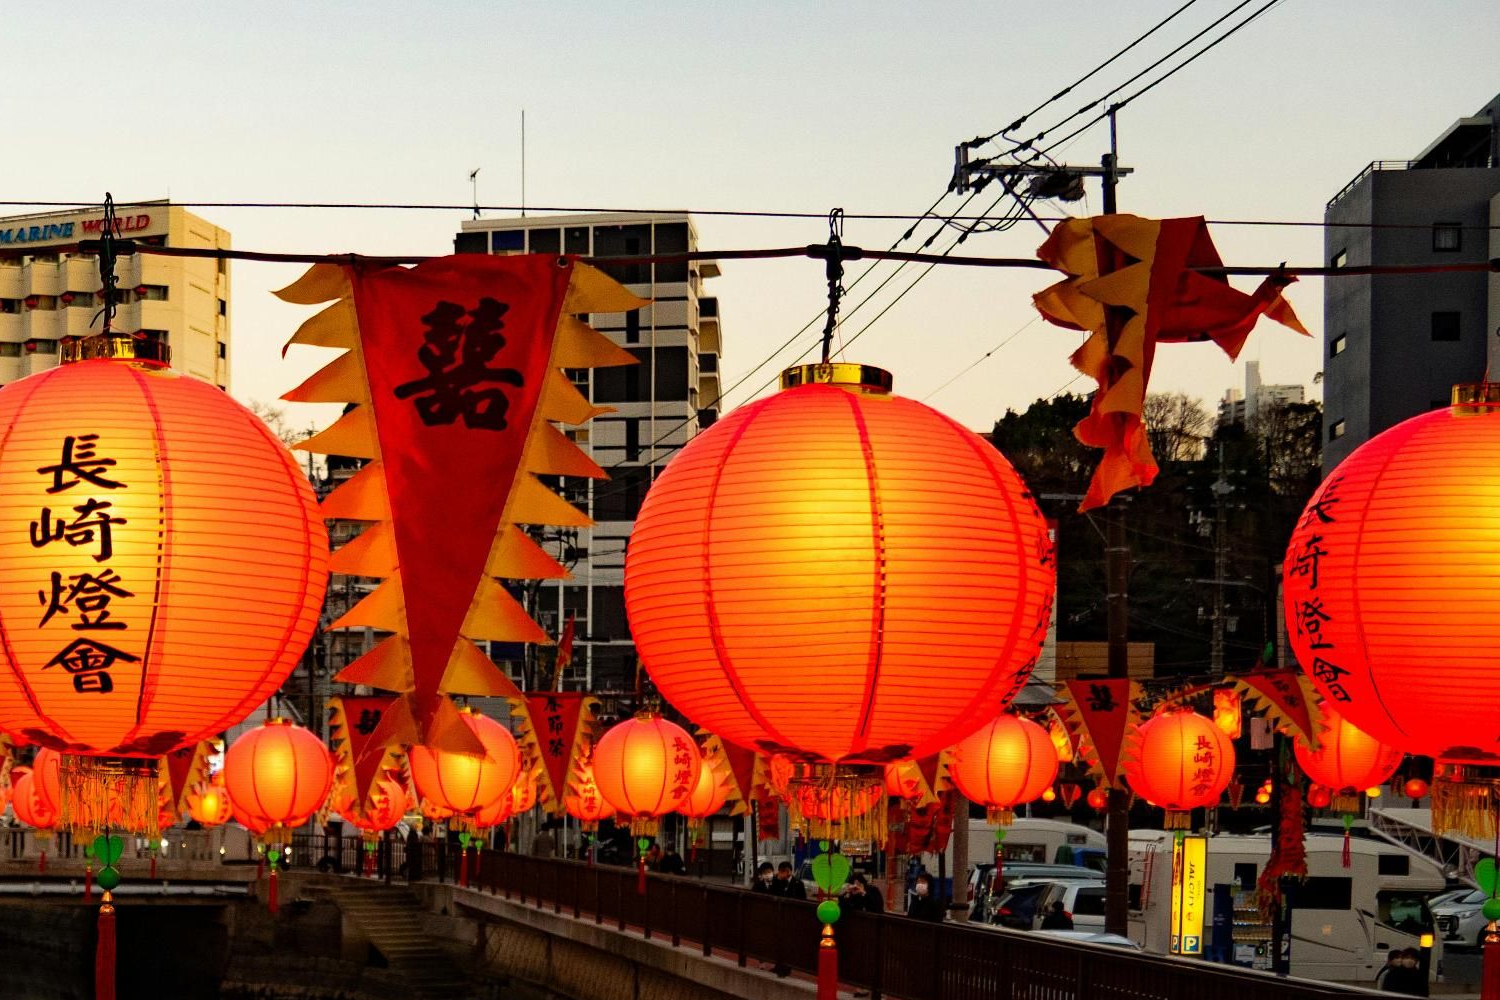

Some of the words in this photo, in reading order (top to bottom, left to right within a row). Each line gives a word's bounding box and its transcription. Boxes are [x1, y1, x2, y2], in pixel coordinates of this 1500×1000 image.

[81, 214, 150, 234] WORLD
[30, 433, 142, 694] 長崎燈會
[671, 736, 692, 800] 長崎燈會
[1190, 735, 1216, 797] 長崎燈會
[1185, 936, 1197, 952] P
